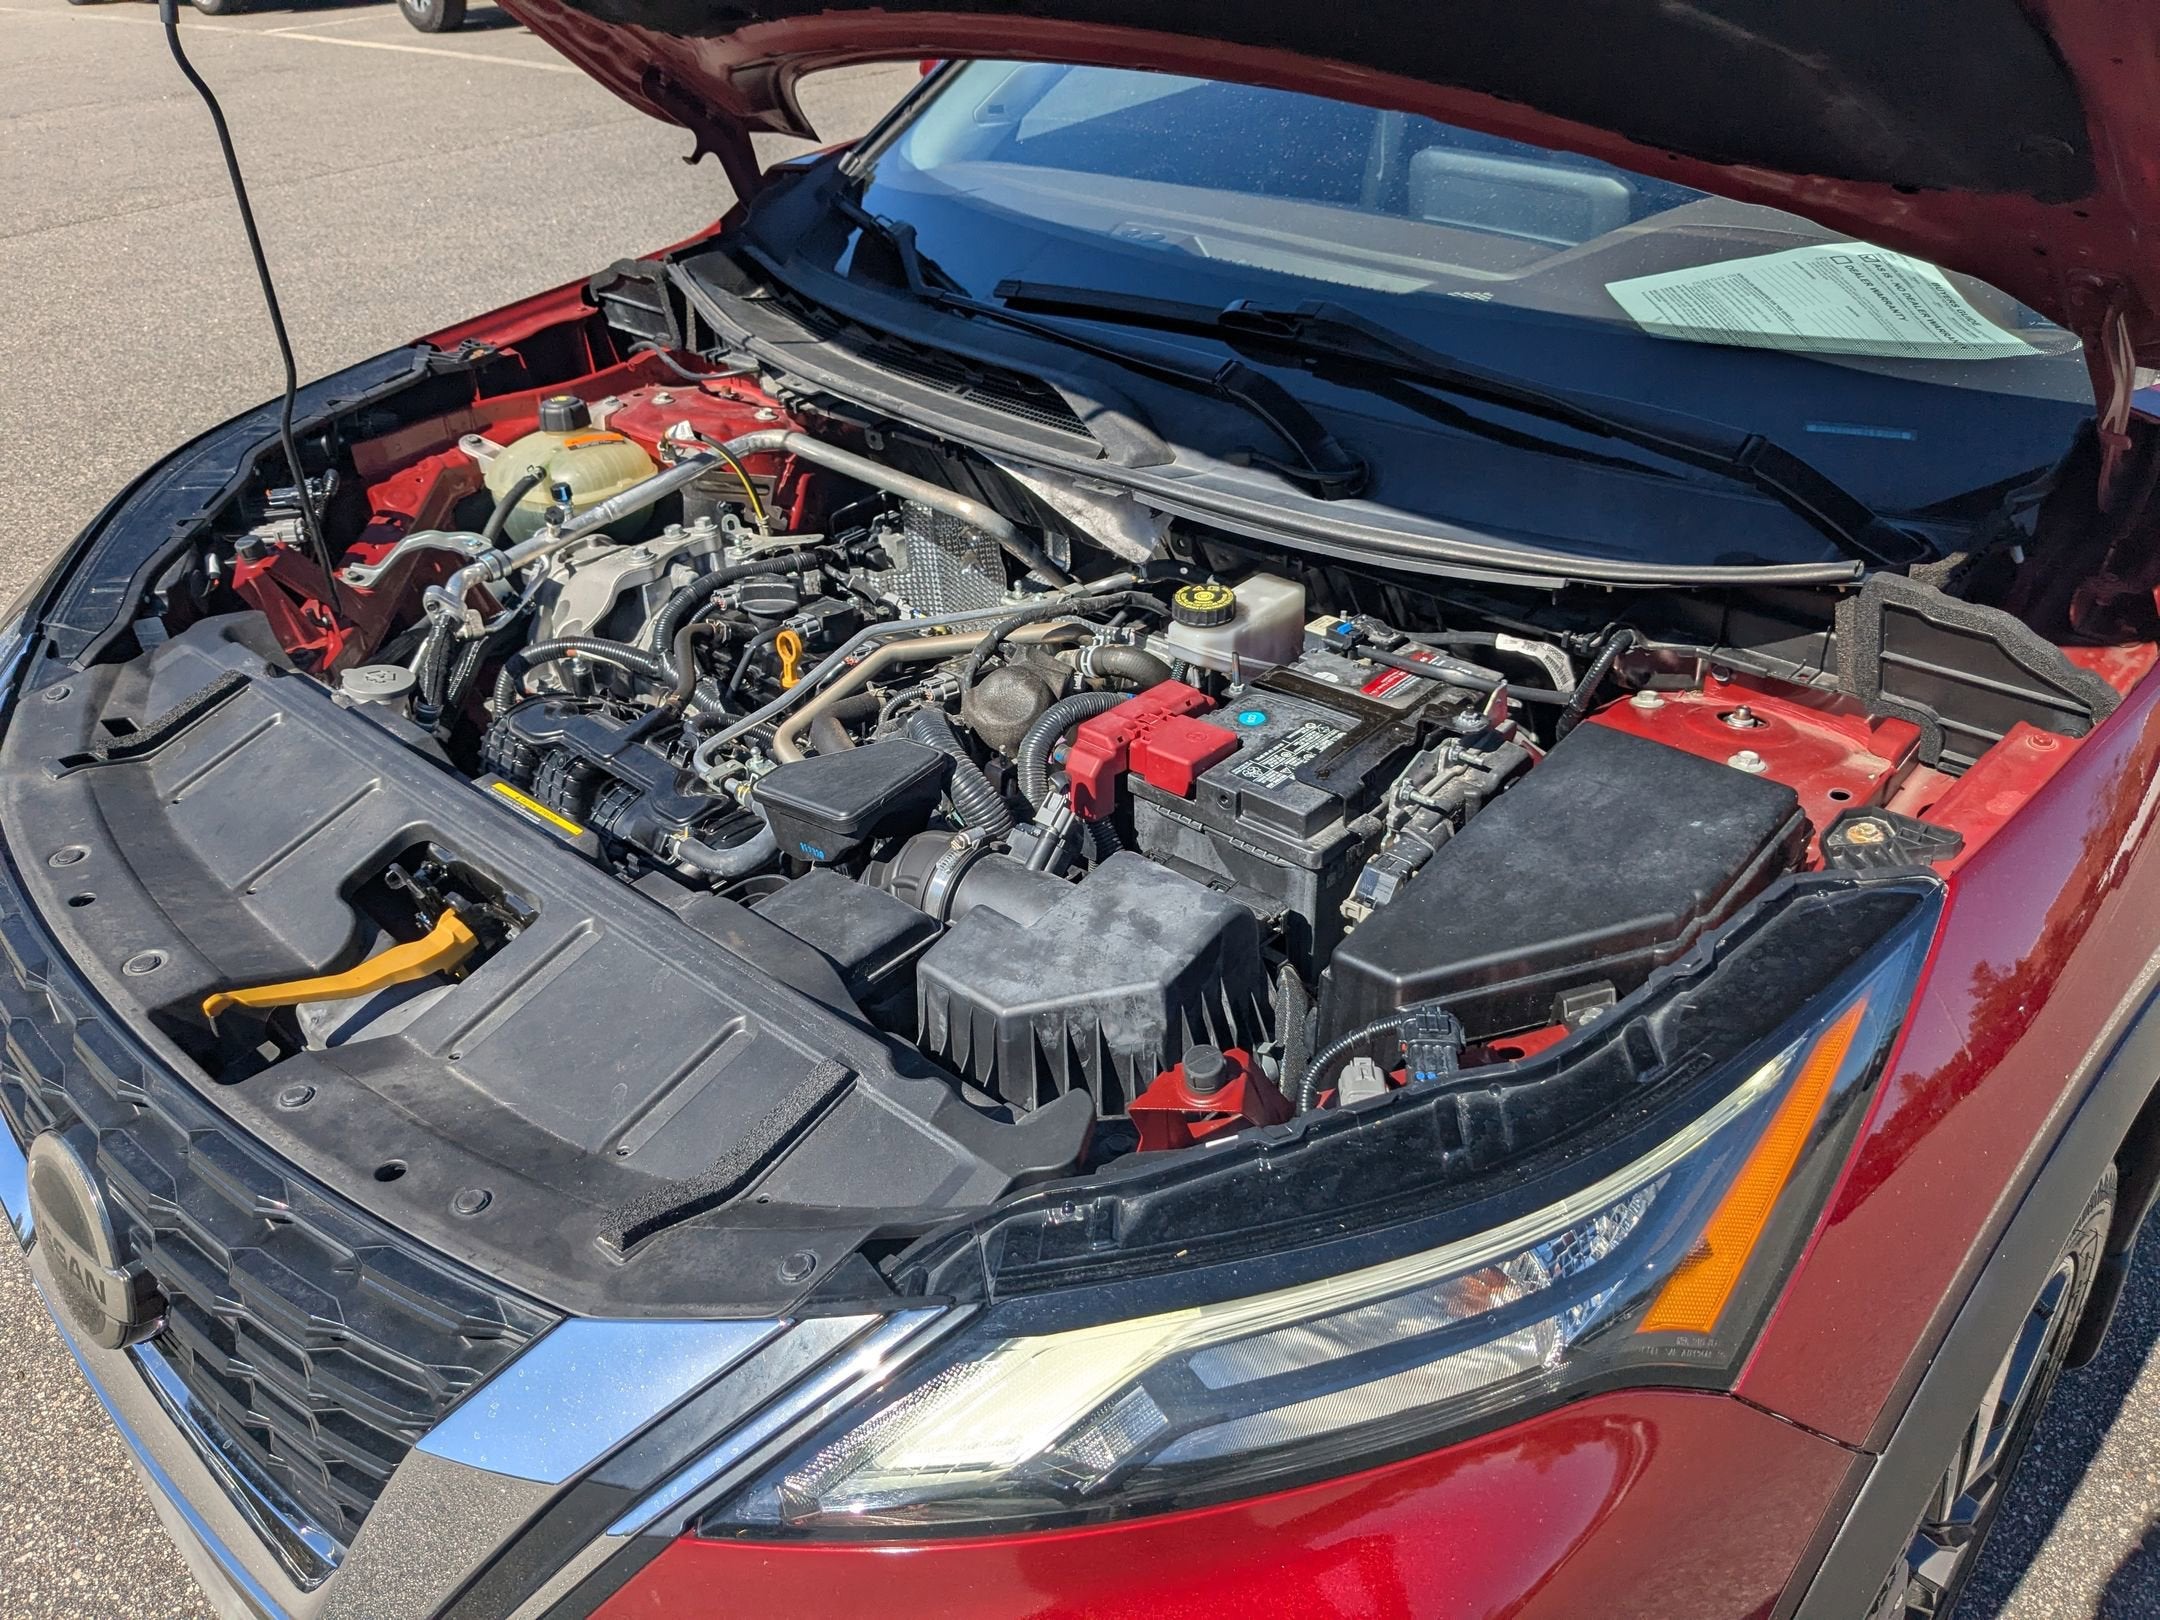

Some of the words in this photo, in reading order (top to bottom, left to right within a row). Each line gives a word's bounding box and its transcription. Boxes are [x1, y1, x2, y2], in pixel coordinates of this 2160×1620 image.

[1844, 265, 1874, 287] DEALER
[1870, 287, 1909, 321] WARRANTY
[1872, 263, 1886, 272] AS
[1892, 282, 1906, 292] NO
[1902, 293, 1931, 318] DEALER
[1956, 307, 1982, 328] GUIDE
